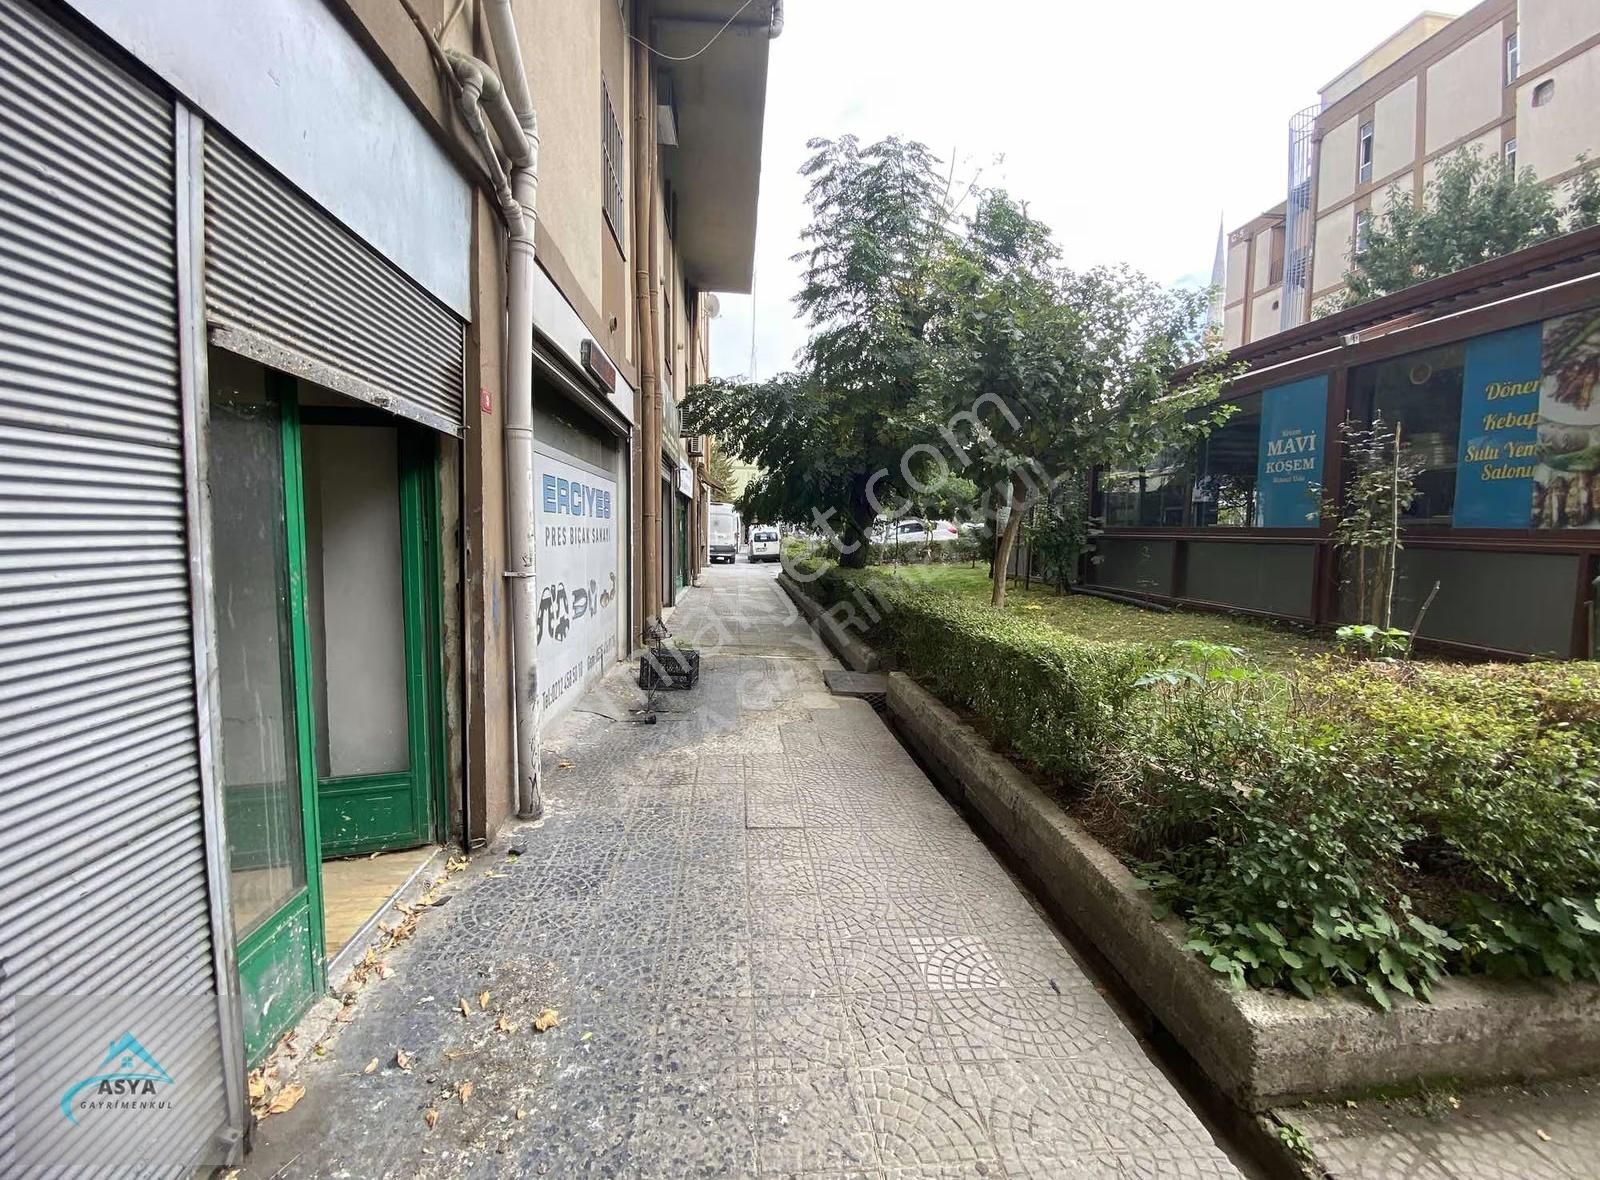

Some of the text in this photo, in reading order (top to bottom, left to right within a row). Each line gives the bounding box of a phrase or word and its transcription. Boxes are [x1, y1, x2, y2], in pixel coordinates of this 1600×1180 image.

[1485, 381, 1540, 400] Döner
[1267, 430, 1316, 456] MAVİ
[1464, 445, 1499, 462] Sulu
[545, 526, 567, 547] PRES
